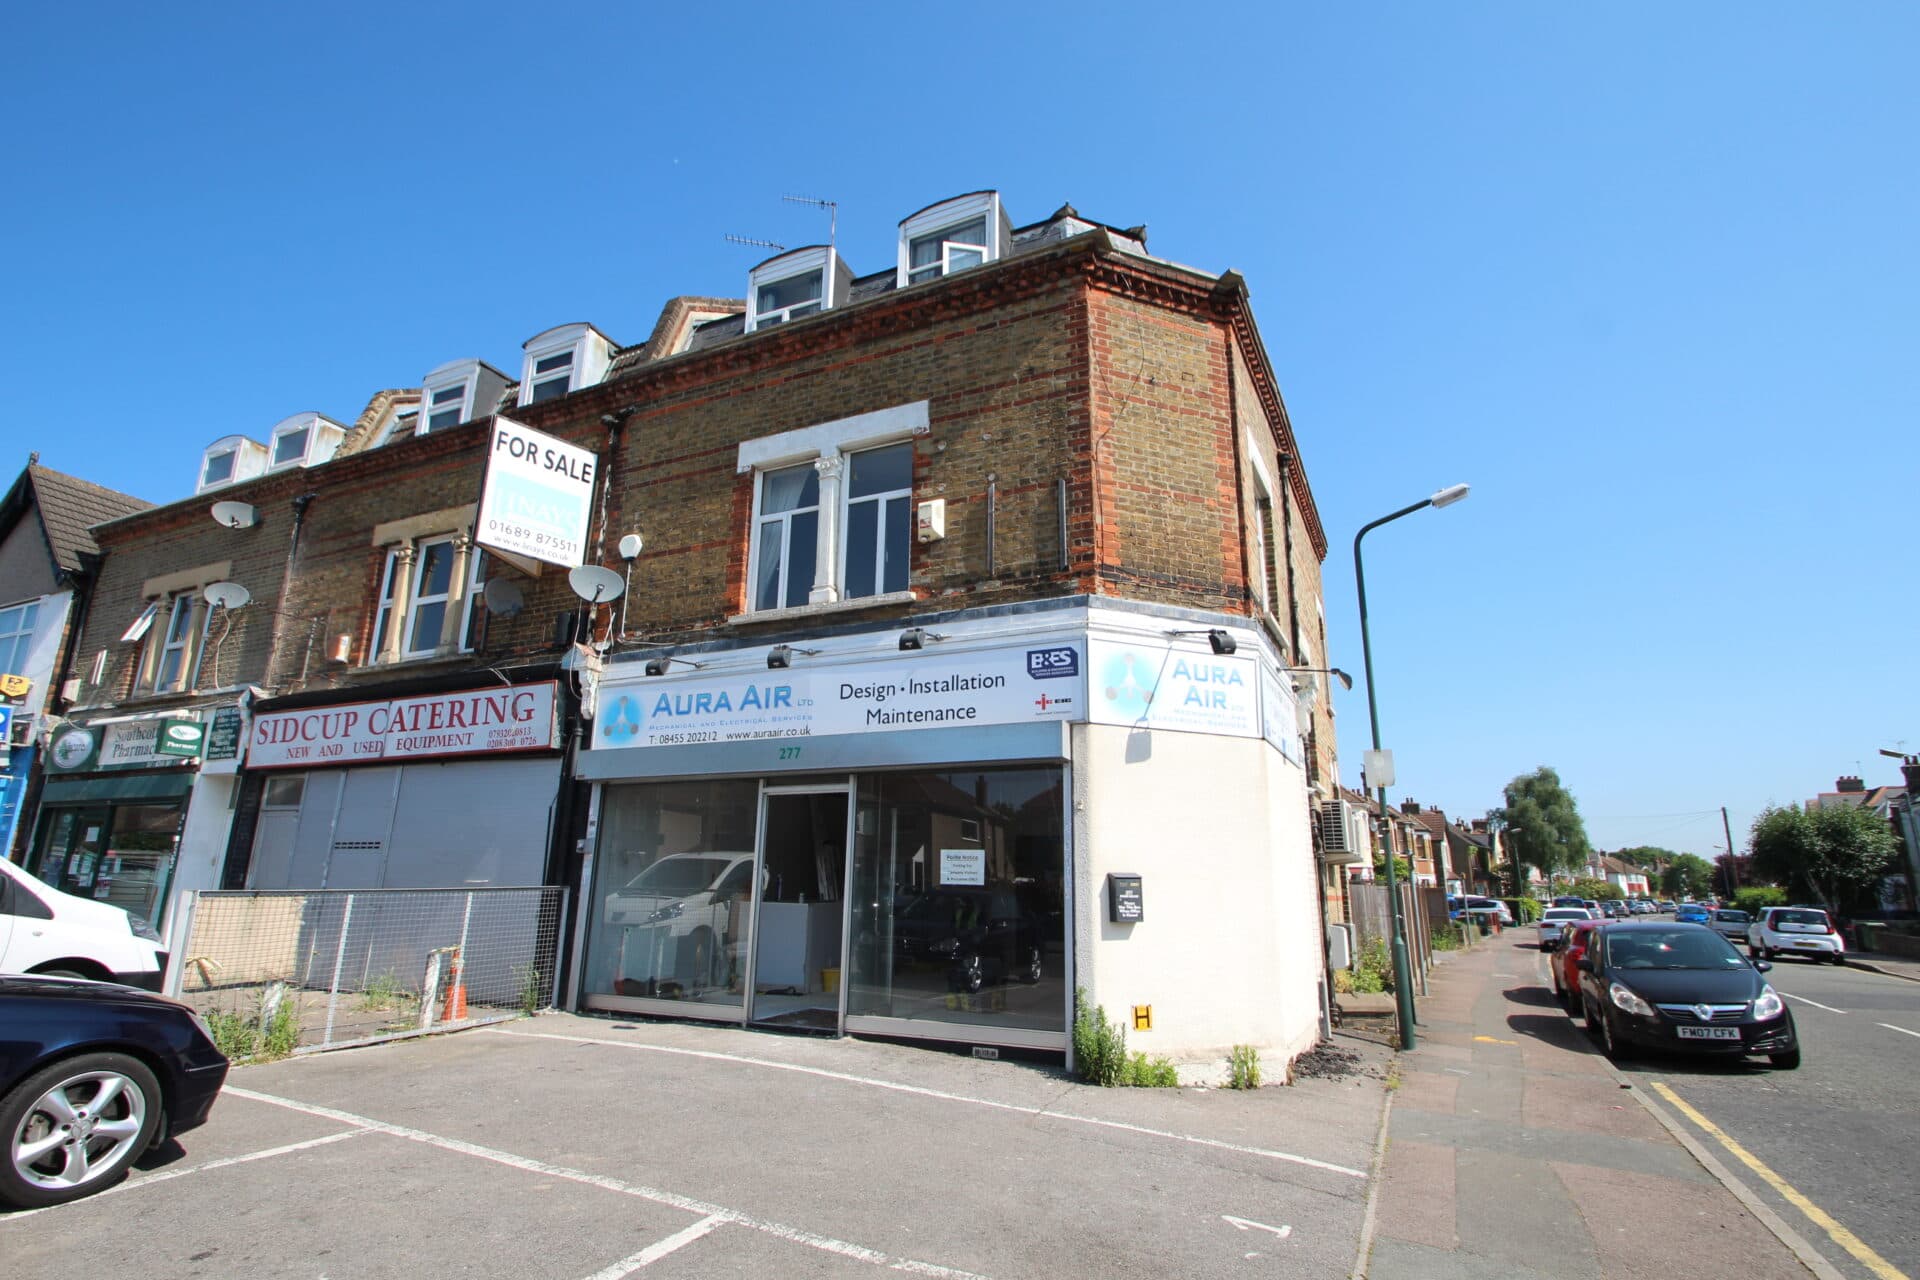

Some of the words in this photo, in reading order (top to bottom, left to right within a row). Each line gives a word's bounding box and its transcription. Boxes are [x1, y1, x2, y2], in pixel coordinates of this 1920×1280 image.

[496, 430, 539, 465] FOR
[544, 449, 593, 484] SALE
[489, 519, 531, 539] 01689
[535, 533, 578, 553] 875511
[1031, 650, 1072, 669] B&ES
[1172, 658, 1244, 687] AURA
[840, 682, 896, 702] Design
[909, 673, 1005, 695] Installation
[1184, 685, 1228, 710] AIR
[652, 691, 733, 718] AURA
[739, 684, 792, 712] AIR
[797, 699, 814, 707] LTD
[257, 710, 359, 746] SIDCUP
[368, 691, 536, 735] CATERING
[866, 704, 977, 726] Maintenance
[286, 745, 312, 760] NEW
[318, 743, 344, 757] AND
[353, 740, 385, 755] USED
[396, 732, 475, 751] EQUIPMENT
[649, 735, 657, 745] T:
[659, 732, 684, 745] 08455
[687, 731, 718, 743] 202212
[726, 725, 811, 740] www.auraair.co.uk
[112, 744, 156, 759] Pharmac
[779, 747, 801, 760] 277
[1134, 1005, 1150, 1029] H
[1713, 1028, 1738, 1038] CFK
